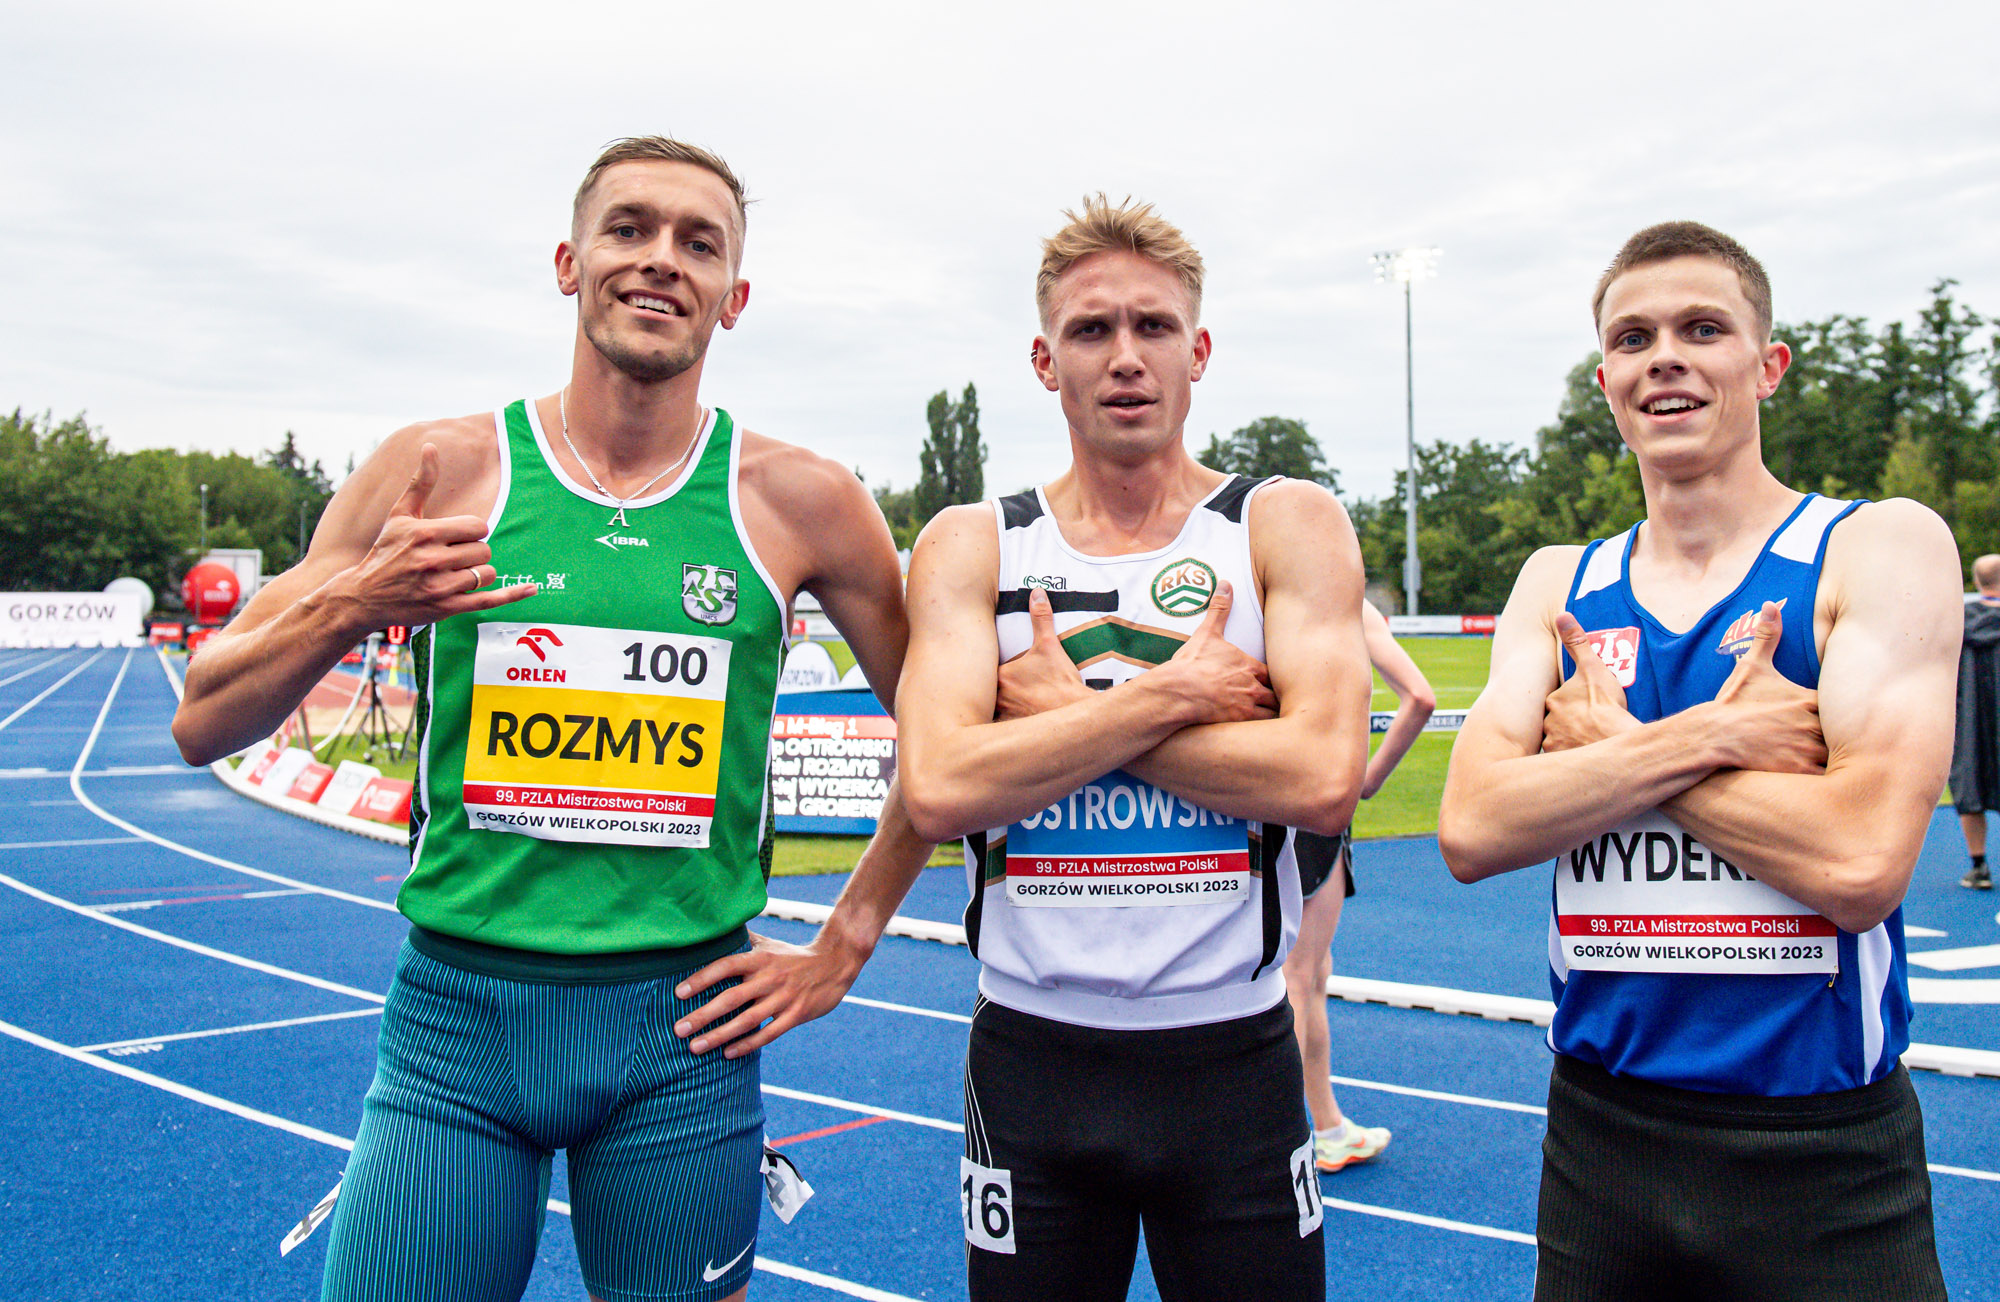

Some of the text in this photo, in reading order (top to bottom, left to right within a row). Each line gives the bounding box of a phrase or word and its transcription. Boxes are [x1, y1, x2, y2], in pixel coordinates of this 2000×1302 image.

[1161, 565, 1207, 593] RKS
[8, 600, 117, 622] GORZÓW
[506, 667, 567, 683] ORLEN
[623, 642, 708, 686] 100
[487, 711, 705, 768] ROZMYS
[495, 789, 687, 813] 99. PZLA Mistrzostwa Polski
[1019, 785, 1234, 830] STROWS
[476, 811, 701, 836] GORZÓW WIELKOPOLSKI 2023
[1035, 857, 1219, 875] 99. PZLA Mistrzostwa Polski
[1570, 831, 1759, 883] WYDER
[1016, 879, 1239, 896] GORZÓW WIELKOPOLSKI 2023
[1590, 918, 1800, 934] 99. PZLA Mistrzostwa Polski
[1573, 942, 1824, 960] GORZÓW WIELKOPOLSKI 2023
[1295, 1147, 1323, 1218] 1
[962, 1173, 1011, 1239] 16
